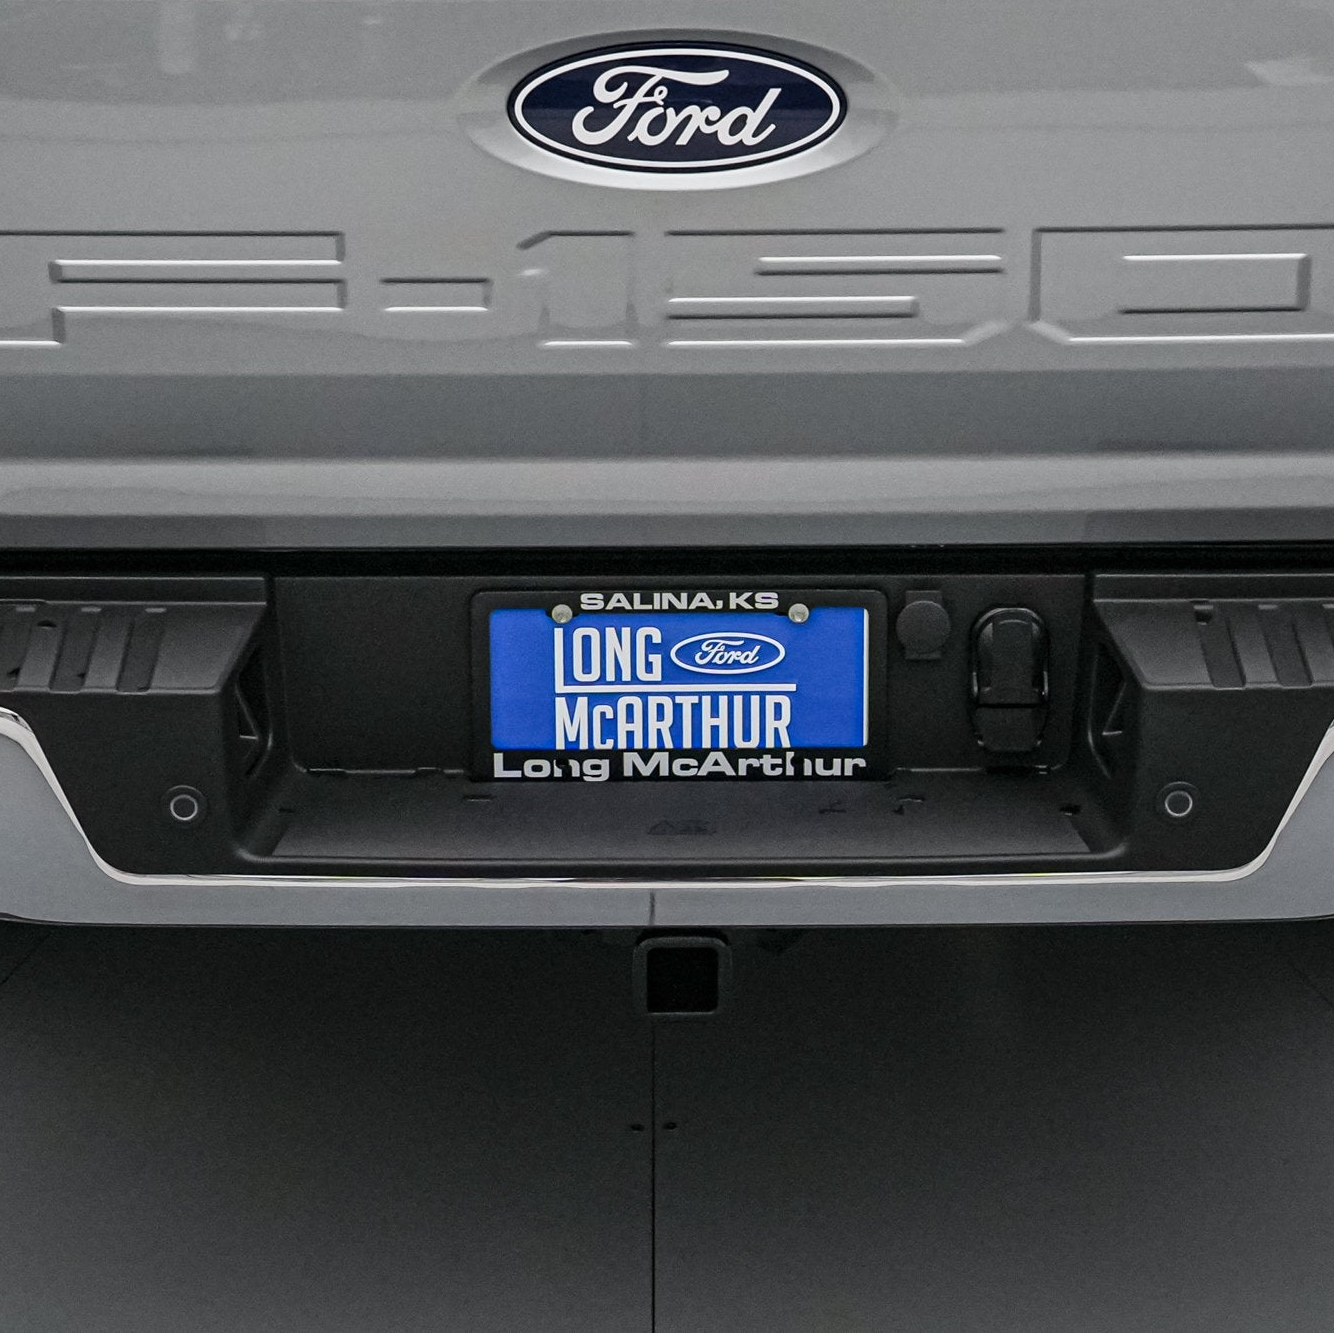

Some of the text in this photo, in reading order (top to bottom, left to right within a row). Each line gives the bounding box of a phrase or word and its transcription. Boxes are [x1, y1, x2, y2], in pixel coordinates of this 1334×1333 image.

[572, 65, 782, 146] Ford
[580, 592, 779, 611] SALINA, KS
[554, 626, 759, 692] LONG Ford
[555, 695, 792, 749] McARTHUR
[493, 752, 609, 782] Long
